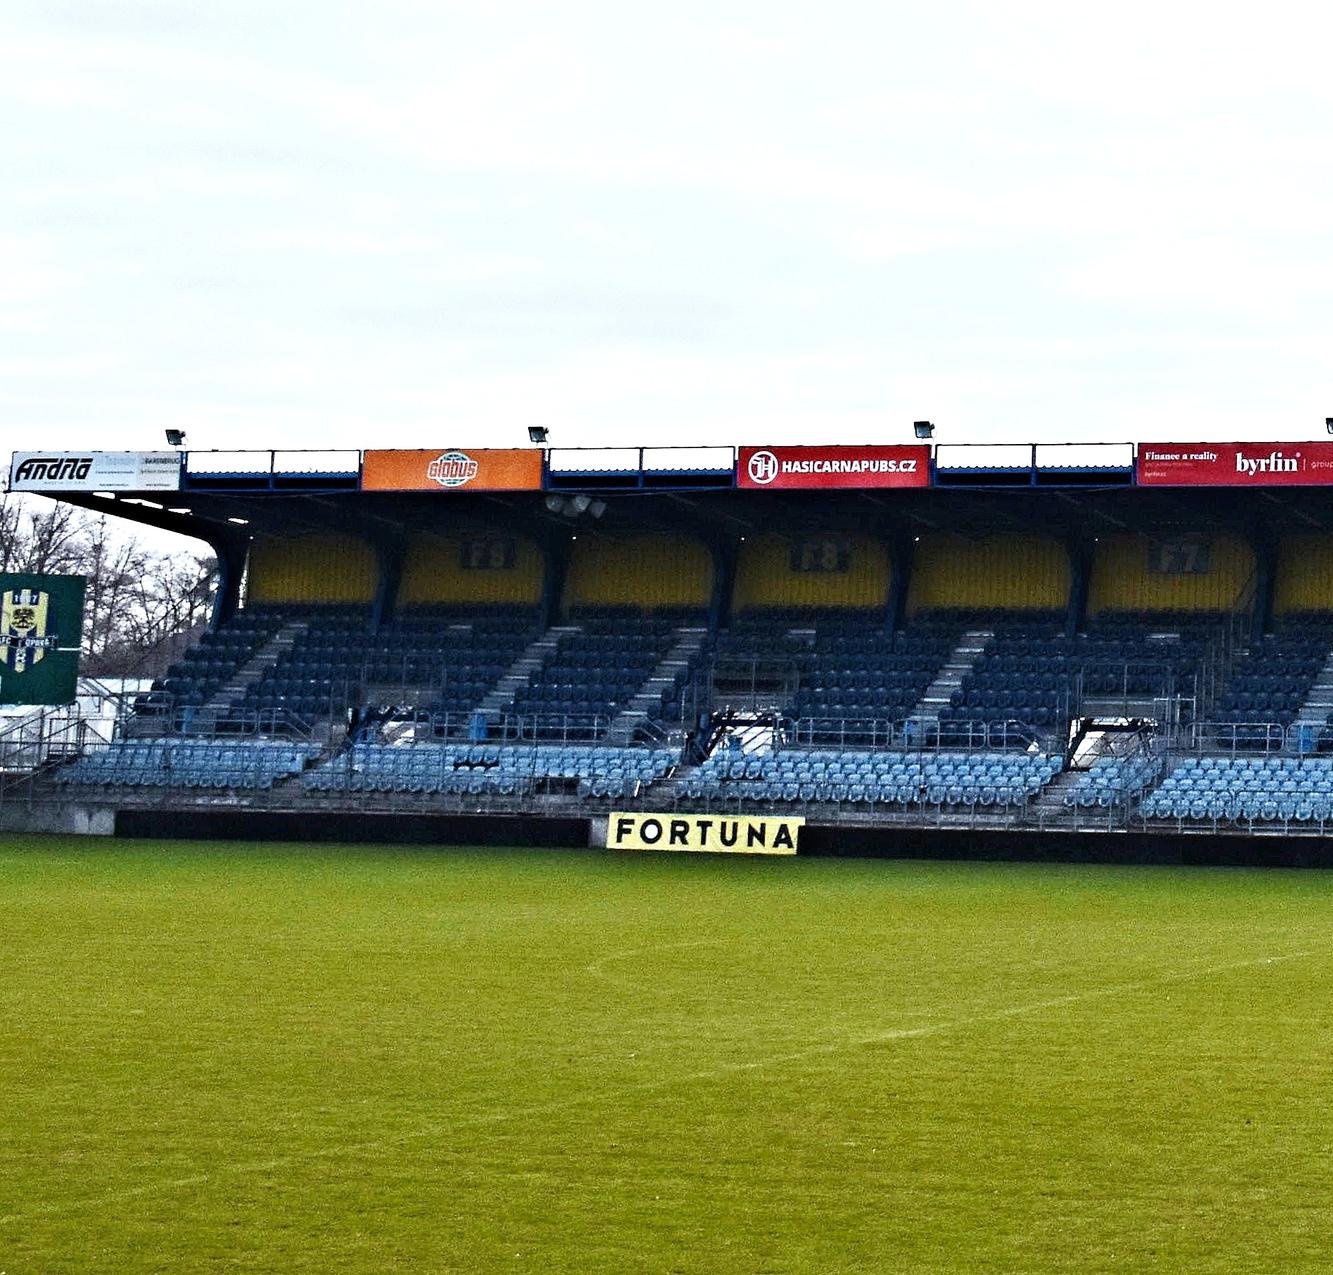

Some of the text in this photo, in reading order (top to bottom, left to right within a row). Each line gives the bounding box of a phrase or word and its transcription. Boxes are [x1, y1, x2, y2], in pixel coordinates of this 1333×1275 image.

[781, 460, 917, 473] HASICARNAPUBS.CZ
[1145, 451, 1180, 460] Finance
[1189, 451, 1217, 462] reality
[1235, 451, 1298, 476] byrfin
[1161, 542, 1199, 573] F7
[616, 818, 795, 849] FORTUNA
